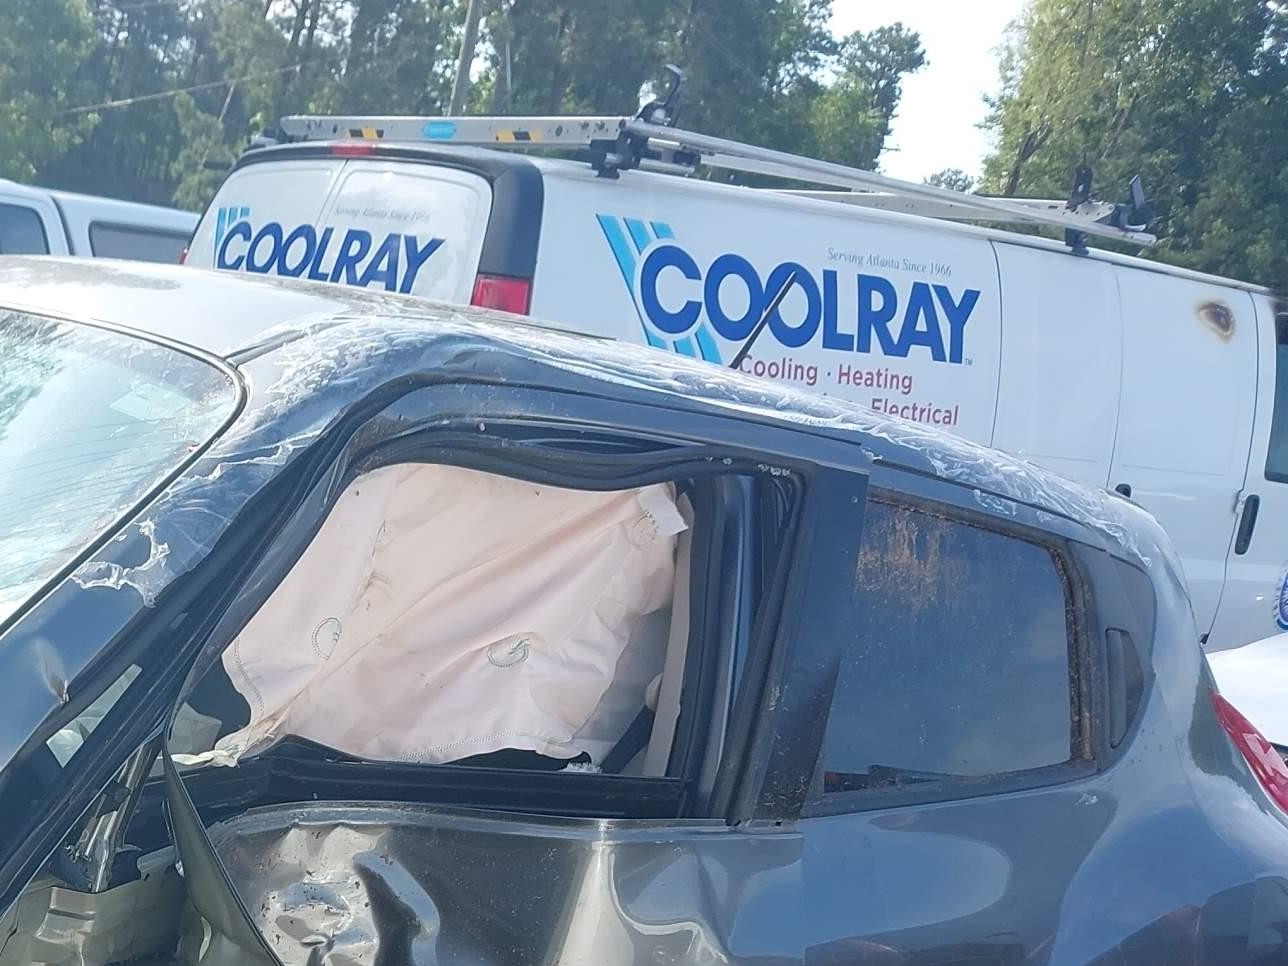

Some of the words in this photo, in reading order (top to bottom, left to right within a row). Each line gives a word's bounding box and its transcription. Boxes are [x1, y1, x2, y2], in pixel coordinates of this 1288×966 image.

[217, 221, 446, 295] COOLRAY
[827, 247, 864, 267] Serving
[866, 253, 900, 270] Atlanta
[902, 258, 927, 273] Since
[929, 262, 952, 277] 1966
[640, 245, 981, 364] COOLRAY
[740, 354, 818, 386] Cooling
[837, 363, 913, 396] Heating
